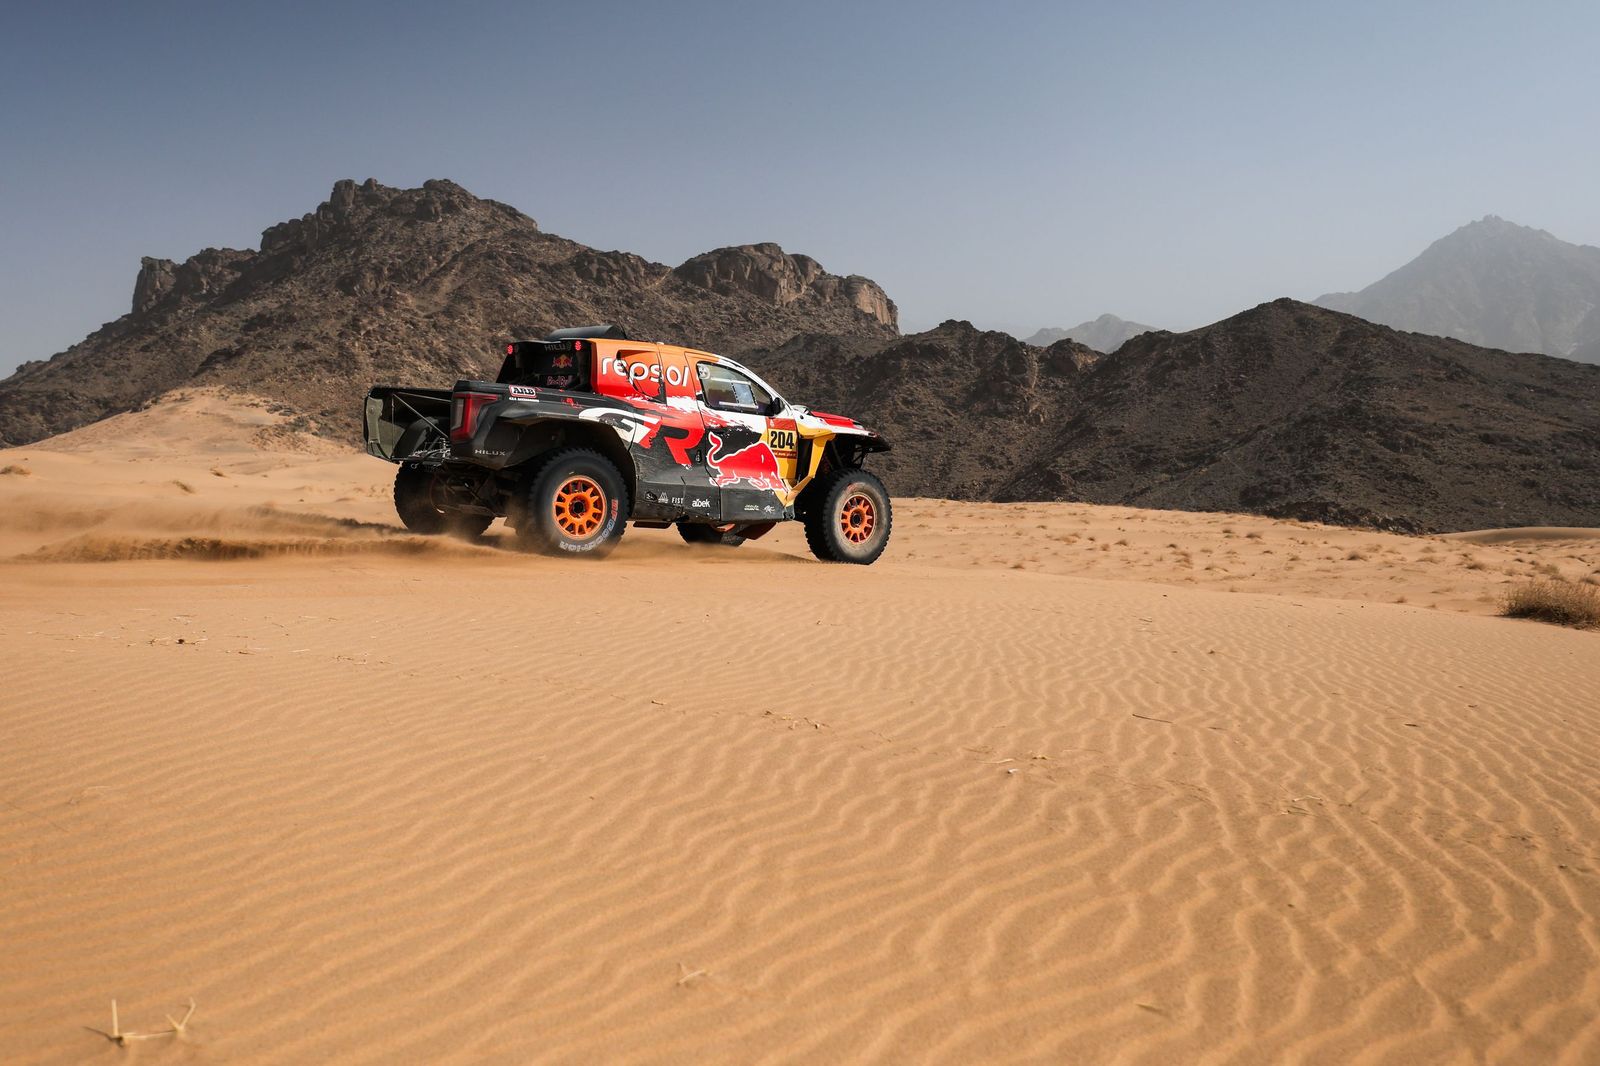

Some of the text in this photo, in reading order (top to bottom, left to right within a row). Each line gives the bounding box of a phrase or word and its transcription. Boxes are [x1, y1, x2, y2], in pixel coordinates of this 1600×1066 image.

[544, 341, 571, 351] HILU
[601, 356, 689, 387] repsol
[513, 387, 535, 395] ARB
[770, 430, 795, 449] 204
